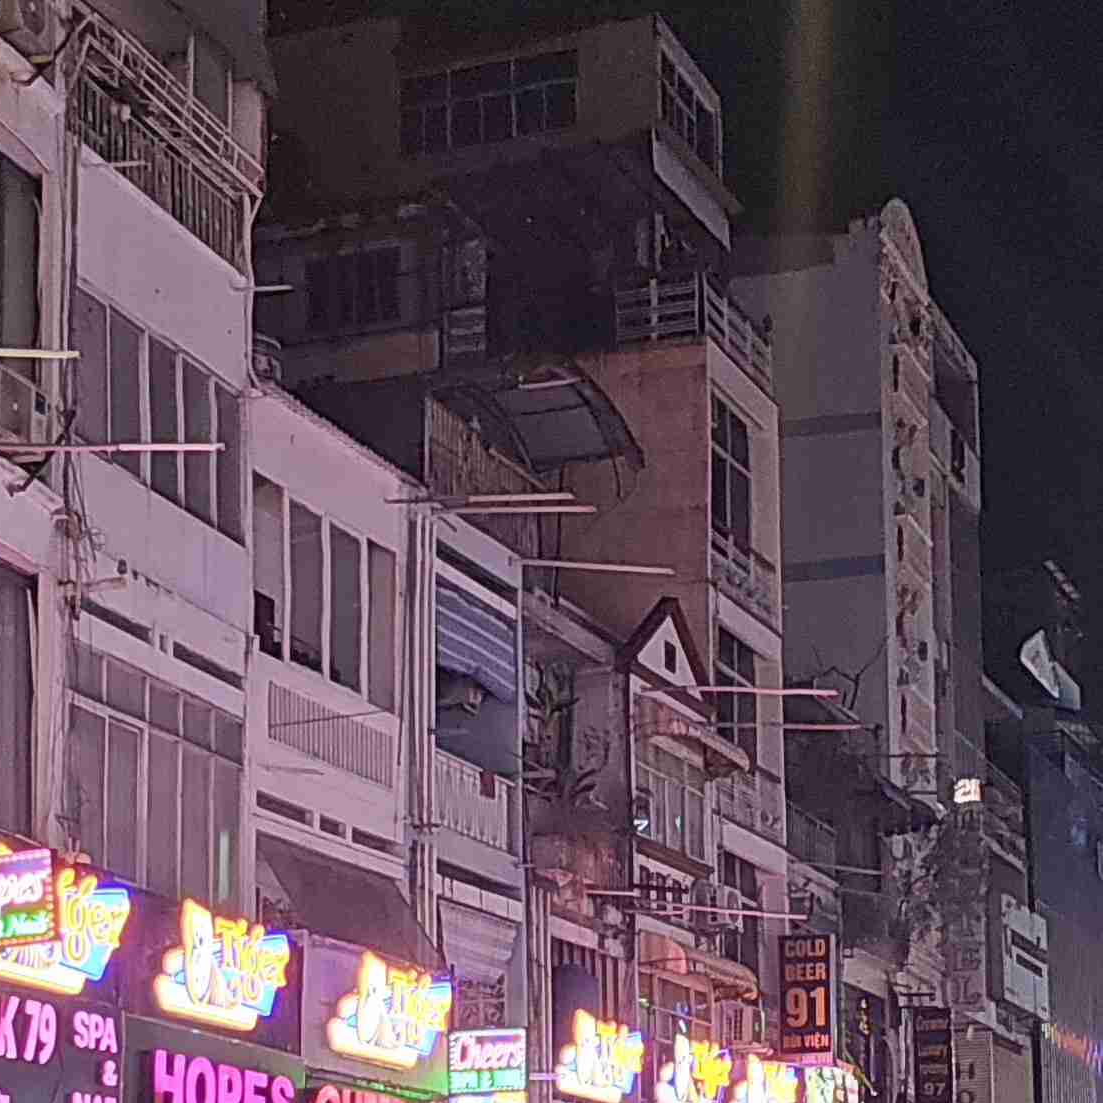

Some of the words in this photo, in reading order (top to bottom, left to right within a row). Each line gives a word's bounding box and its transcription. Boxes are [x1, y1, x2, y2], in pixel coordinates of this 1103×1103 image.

[784, 938, 826, 959] COLD
[784, 962, 827, 982] BEER
[785, 986, 827, 1028] 91
[21, 1000, 57, 1064] 79
[72, 1011, 118, 1054] SPA
[454, 1038, 525, 1071] Cheers
[101, 1060, 118, 1087] &
